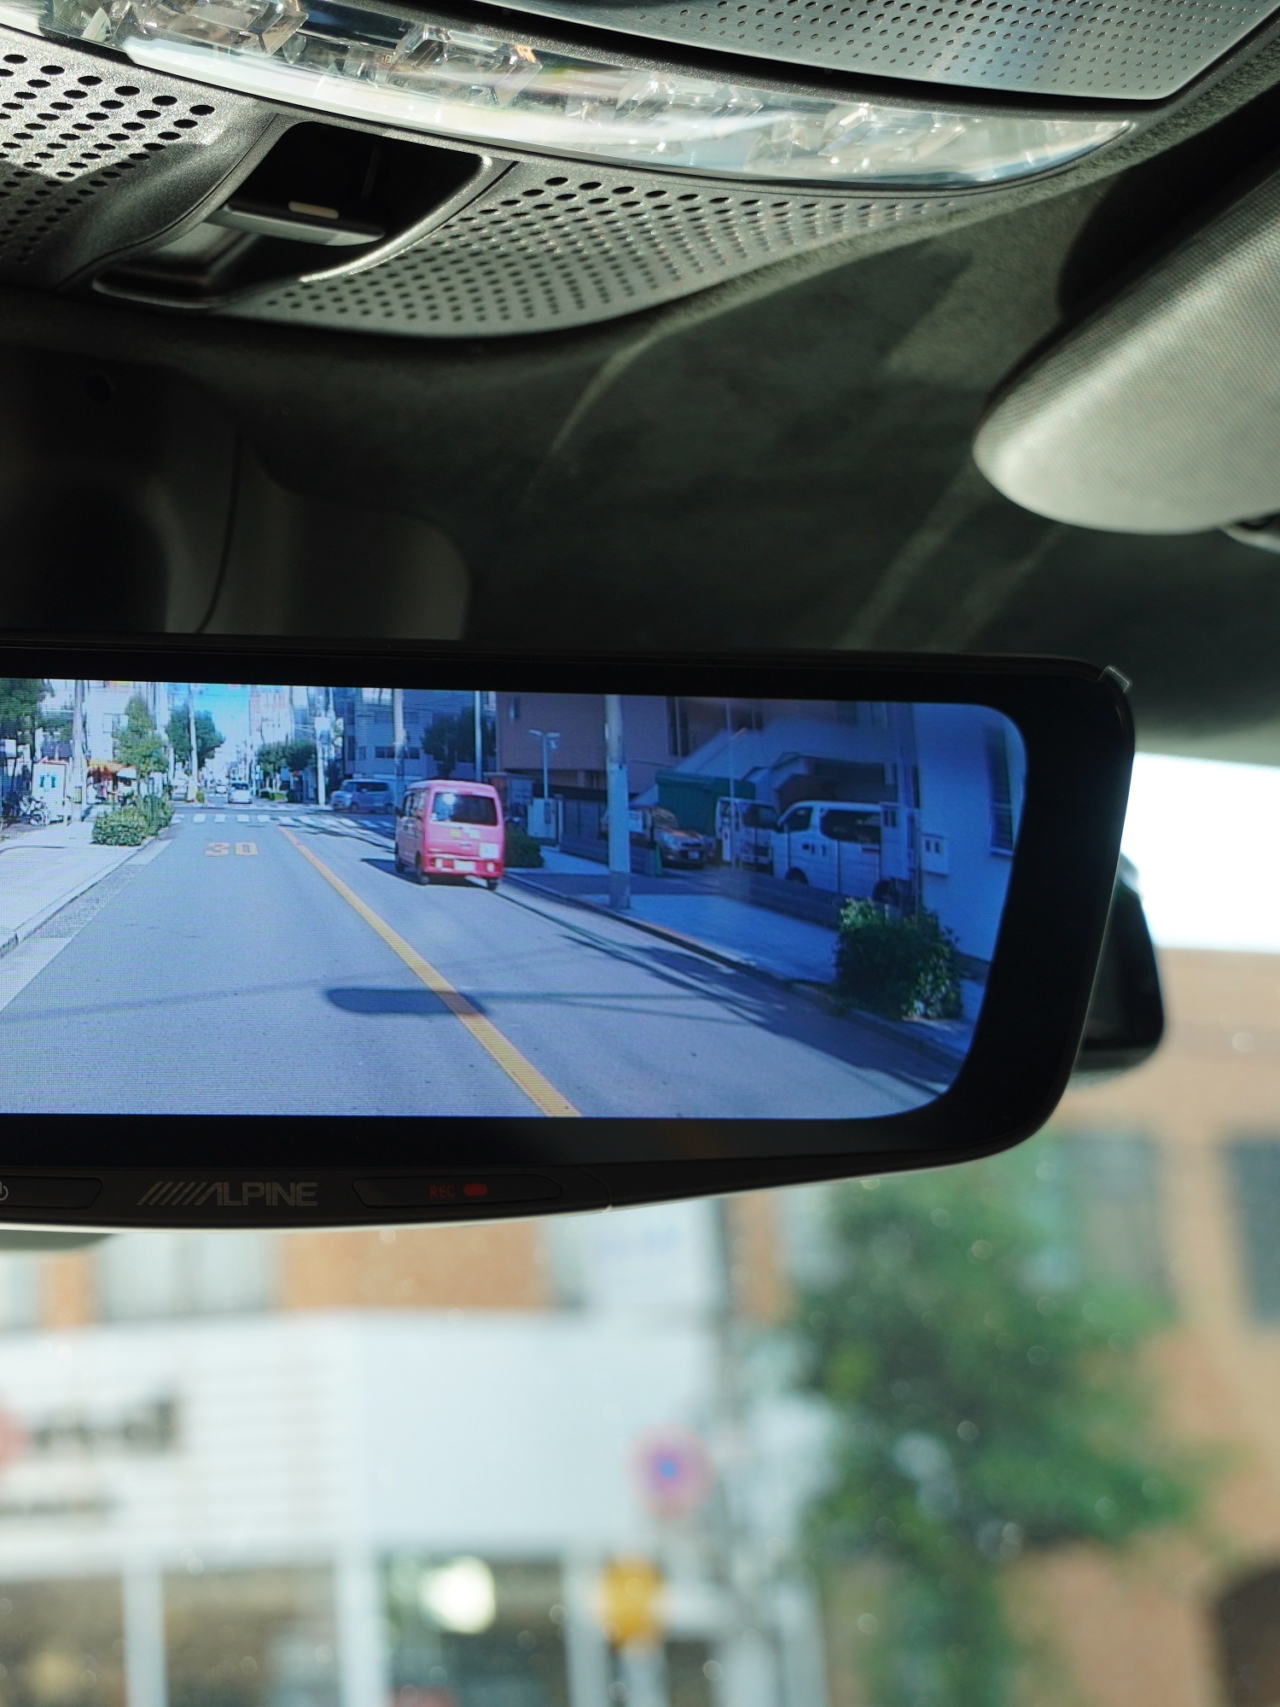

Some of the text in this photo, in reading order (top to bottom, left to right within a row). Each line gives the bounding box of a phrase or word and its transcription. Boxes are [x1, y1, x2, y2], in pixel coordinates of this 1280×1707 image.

[204, 841, 259, 857] 30
[194, 1181, 319, 1207] ALPINE
[429, 1183, 456, 1199] REC
